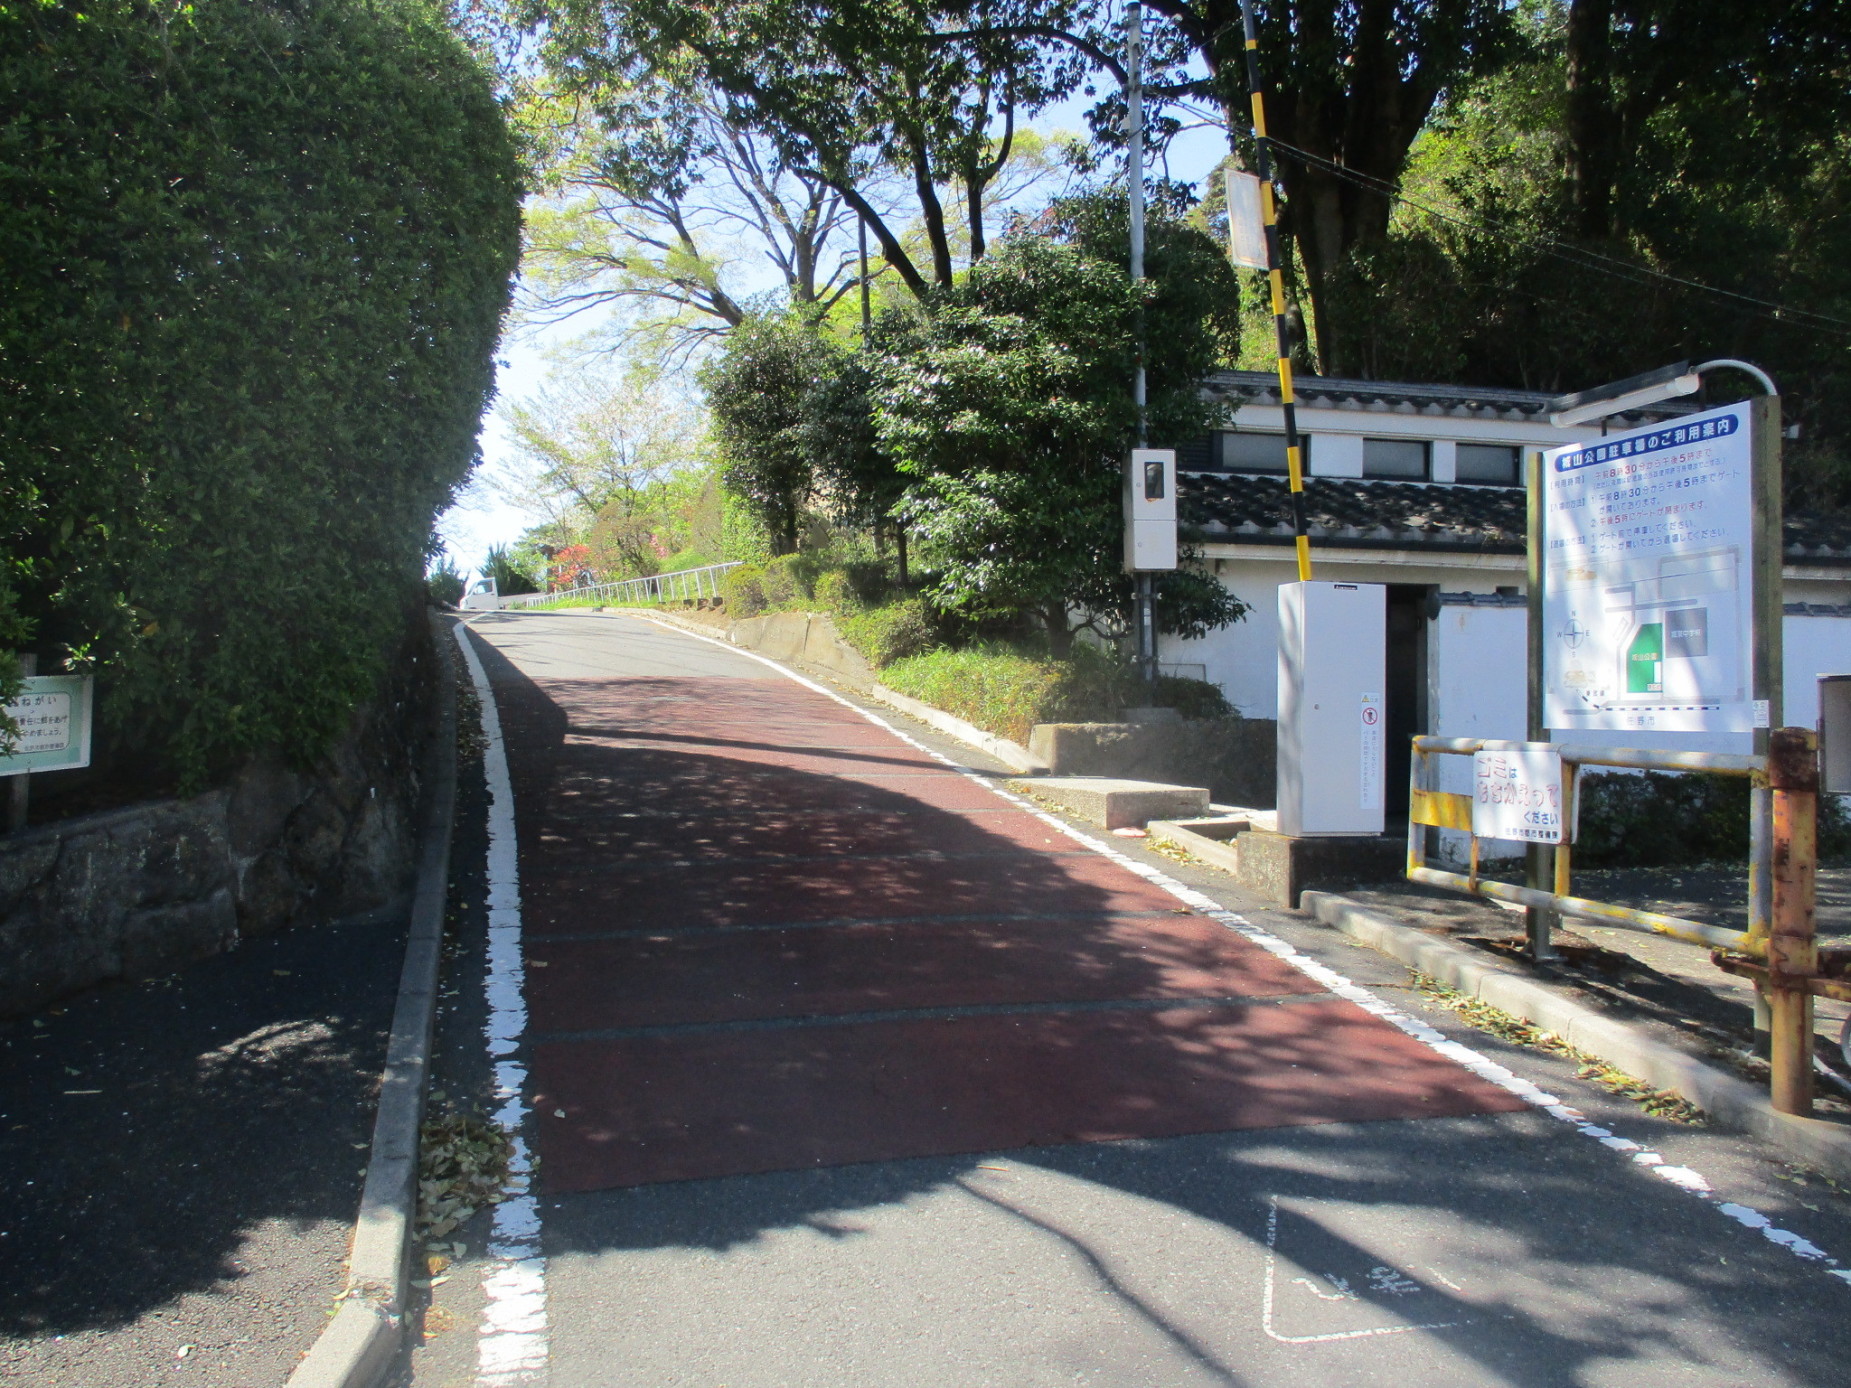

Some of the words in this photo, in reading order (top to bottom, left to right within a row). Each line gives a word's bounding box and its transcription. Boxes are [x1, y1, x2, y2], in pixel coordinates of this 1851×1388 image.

[1560, 418, 1730, 470] 城山公園駐車場のご利用案内
[1476, 780, 1559, 808] もちかえって
[1523, 811, 1558, 825] ください
